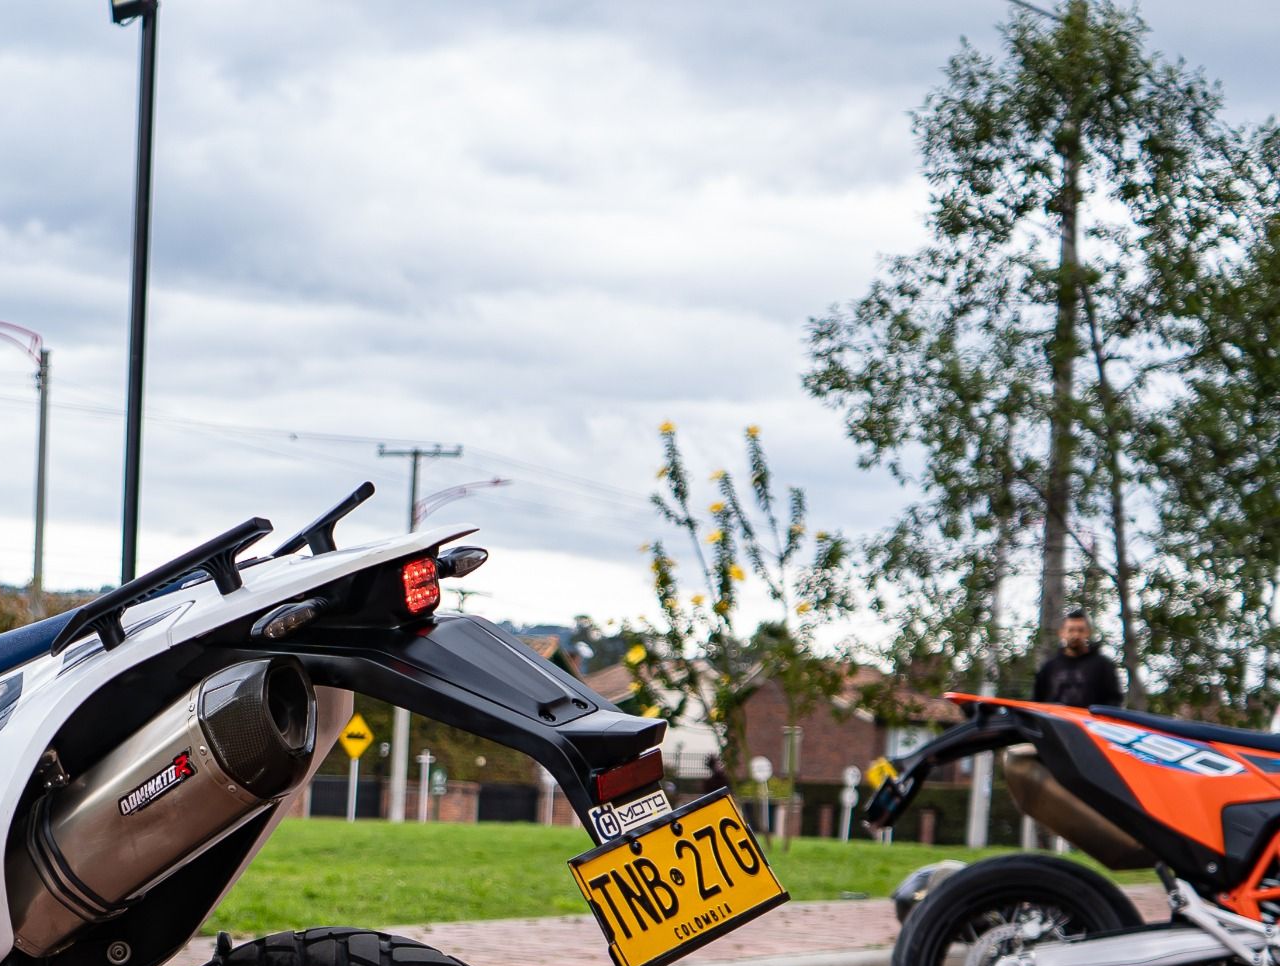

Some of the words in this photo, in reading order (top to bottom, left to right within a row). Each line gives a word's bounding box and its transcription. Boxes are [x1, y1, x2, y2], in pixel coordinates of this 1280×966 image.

[617, 793, 666, 822] MOTO
[588, 857, 680, 940] TNB
[675, 817, 761, 901] 27G
[674, 902, 733, 940] COLOMBIA
